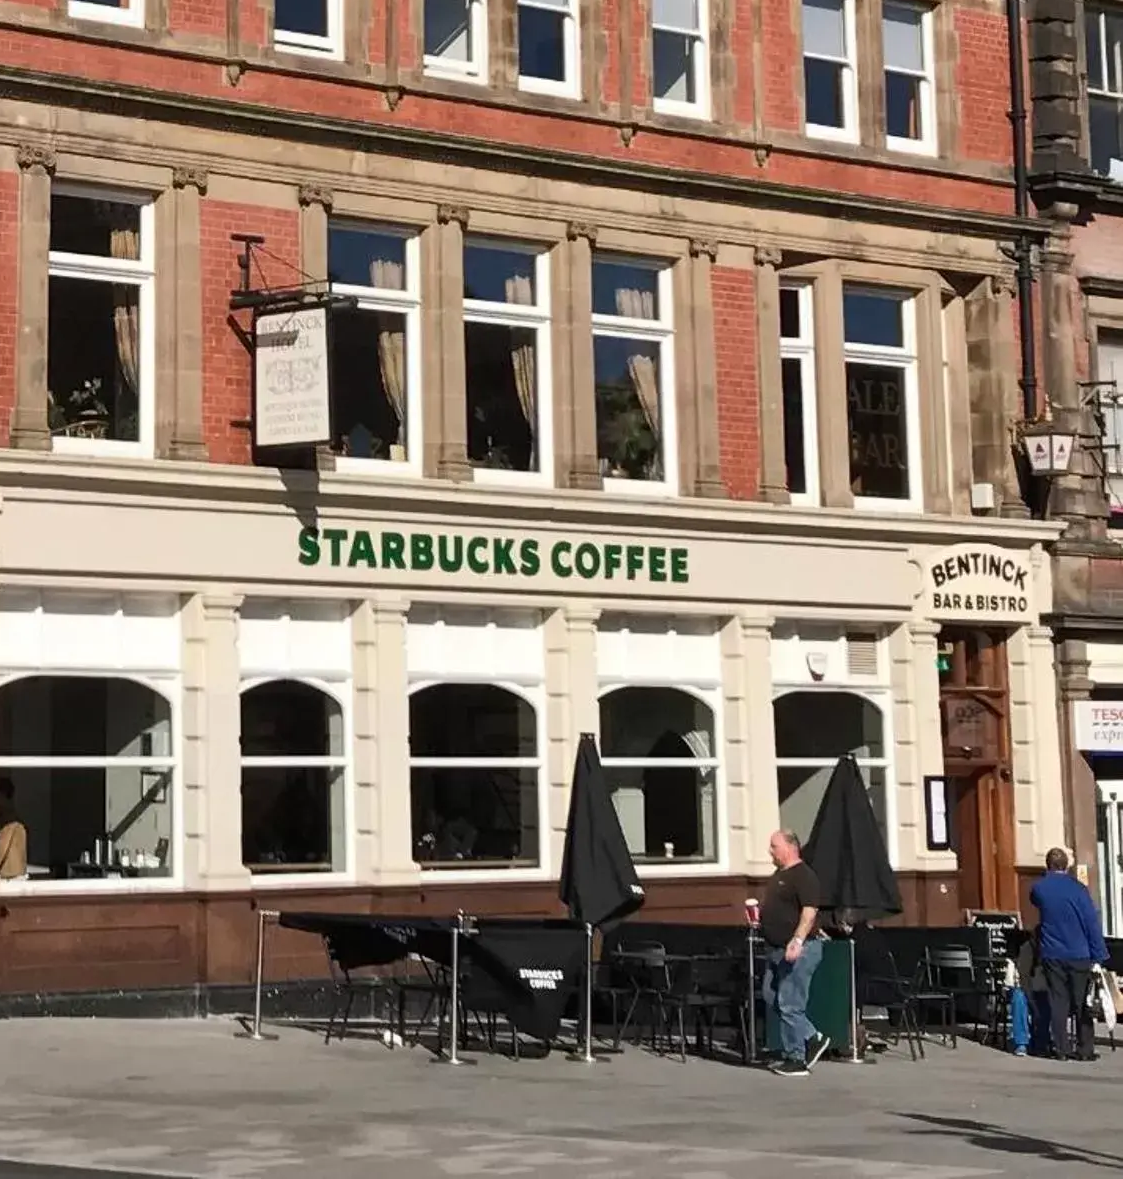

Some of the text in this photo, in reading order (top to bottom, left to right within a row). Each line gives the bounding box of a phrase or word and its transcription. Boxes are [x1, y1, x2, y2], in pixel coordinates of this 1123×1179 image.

[298, 526, 690, 584] STARBUCKS COFFEE
[931, 552, 1029, 592] BENTINCK
[933, 592, 1028, 613] BAR & BISTRO
